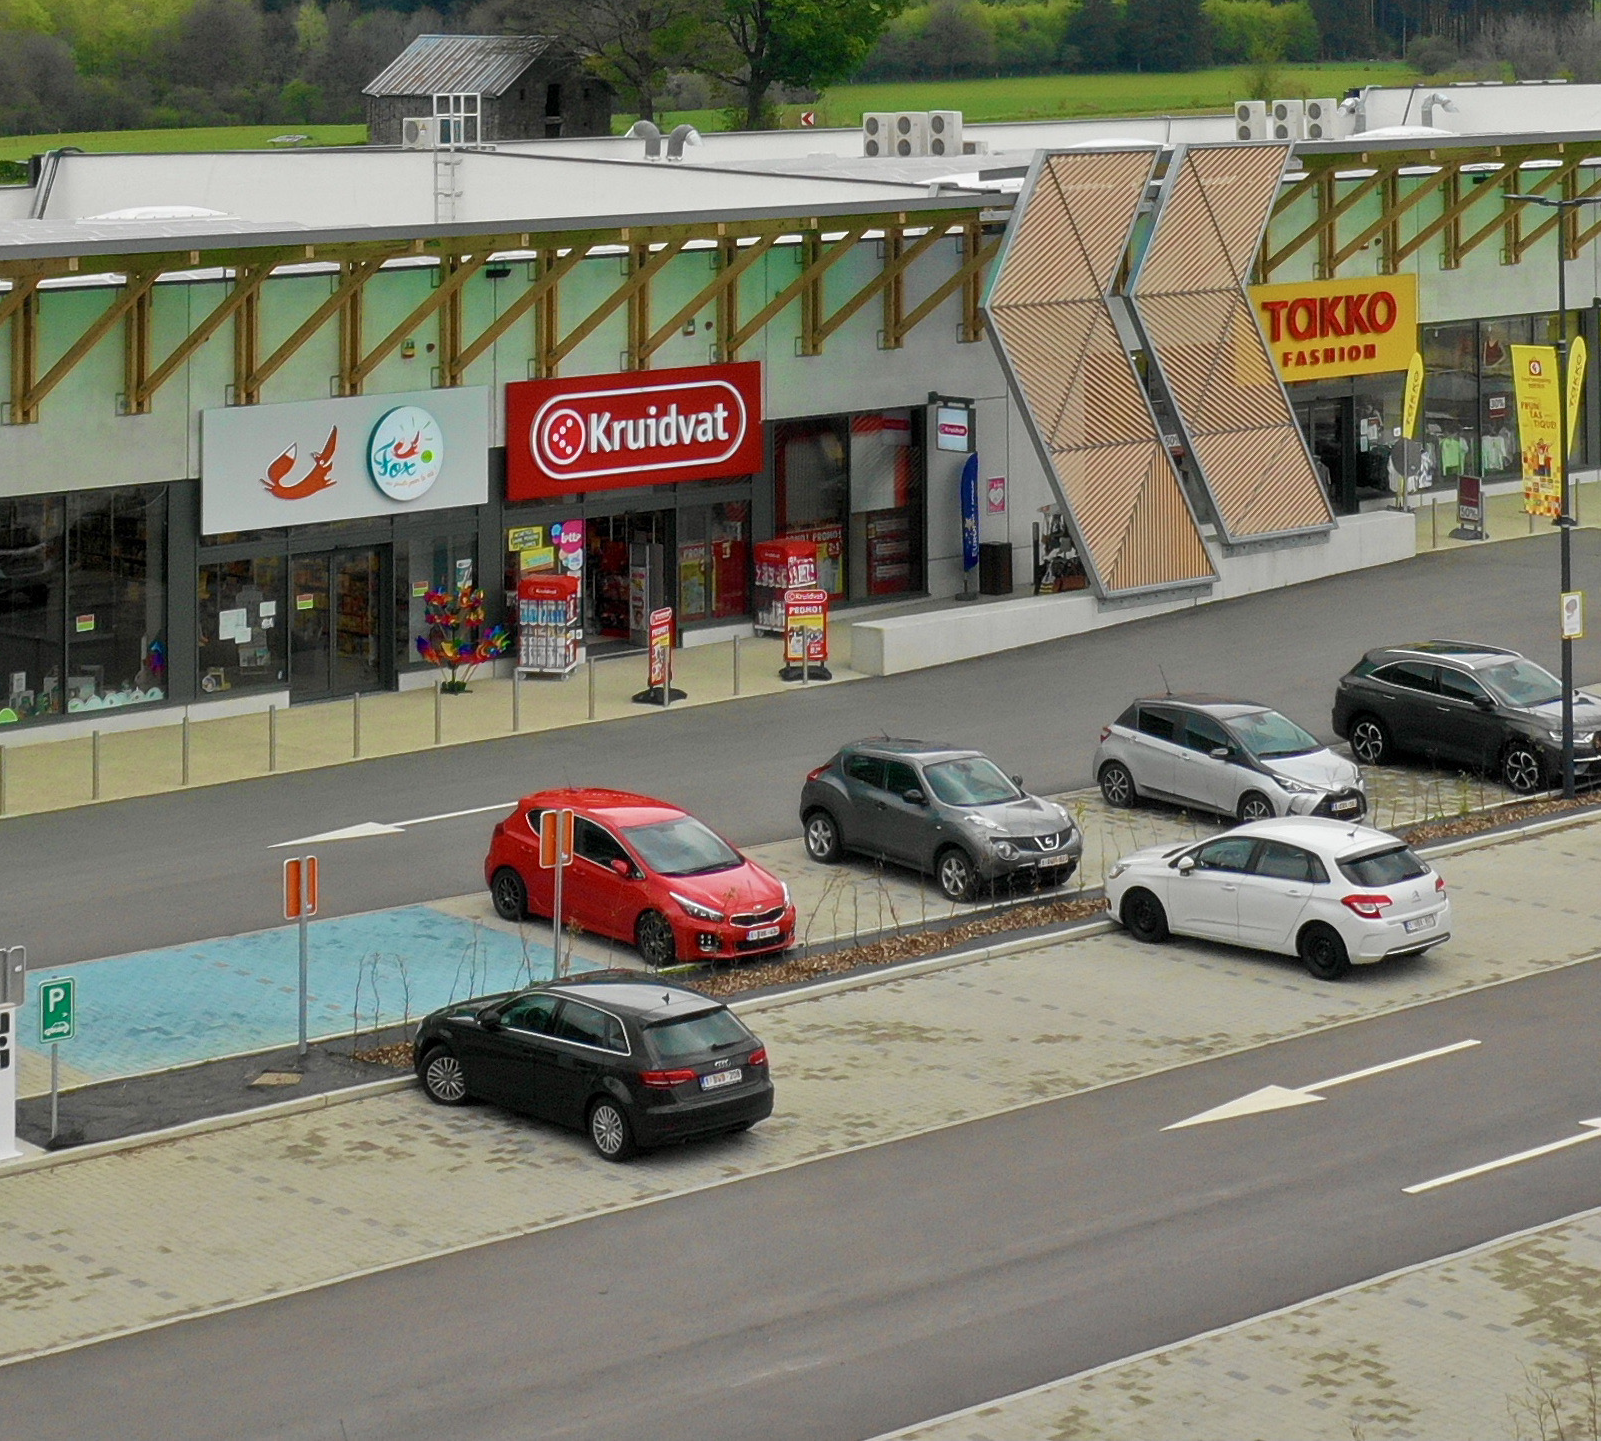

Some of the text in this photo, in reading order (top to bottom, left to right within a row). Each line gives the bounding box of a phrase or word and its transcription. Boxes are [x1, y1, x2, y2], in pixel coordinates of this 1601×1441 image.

[1261, 291, 1397, 343] TAKKO
[1282, 344, 1376, 367] FASHION
[589, 403, 729, 453] Kruidvat
[374, 437, 416, 478] Fox
[49, 988, 65, 1013] P
